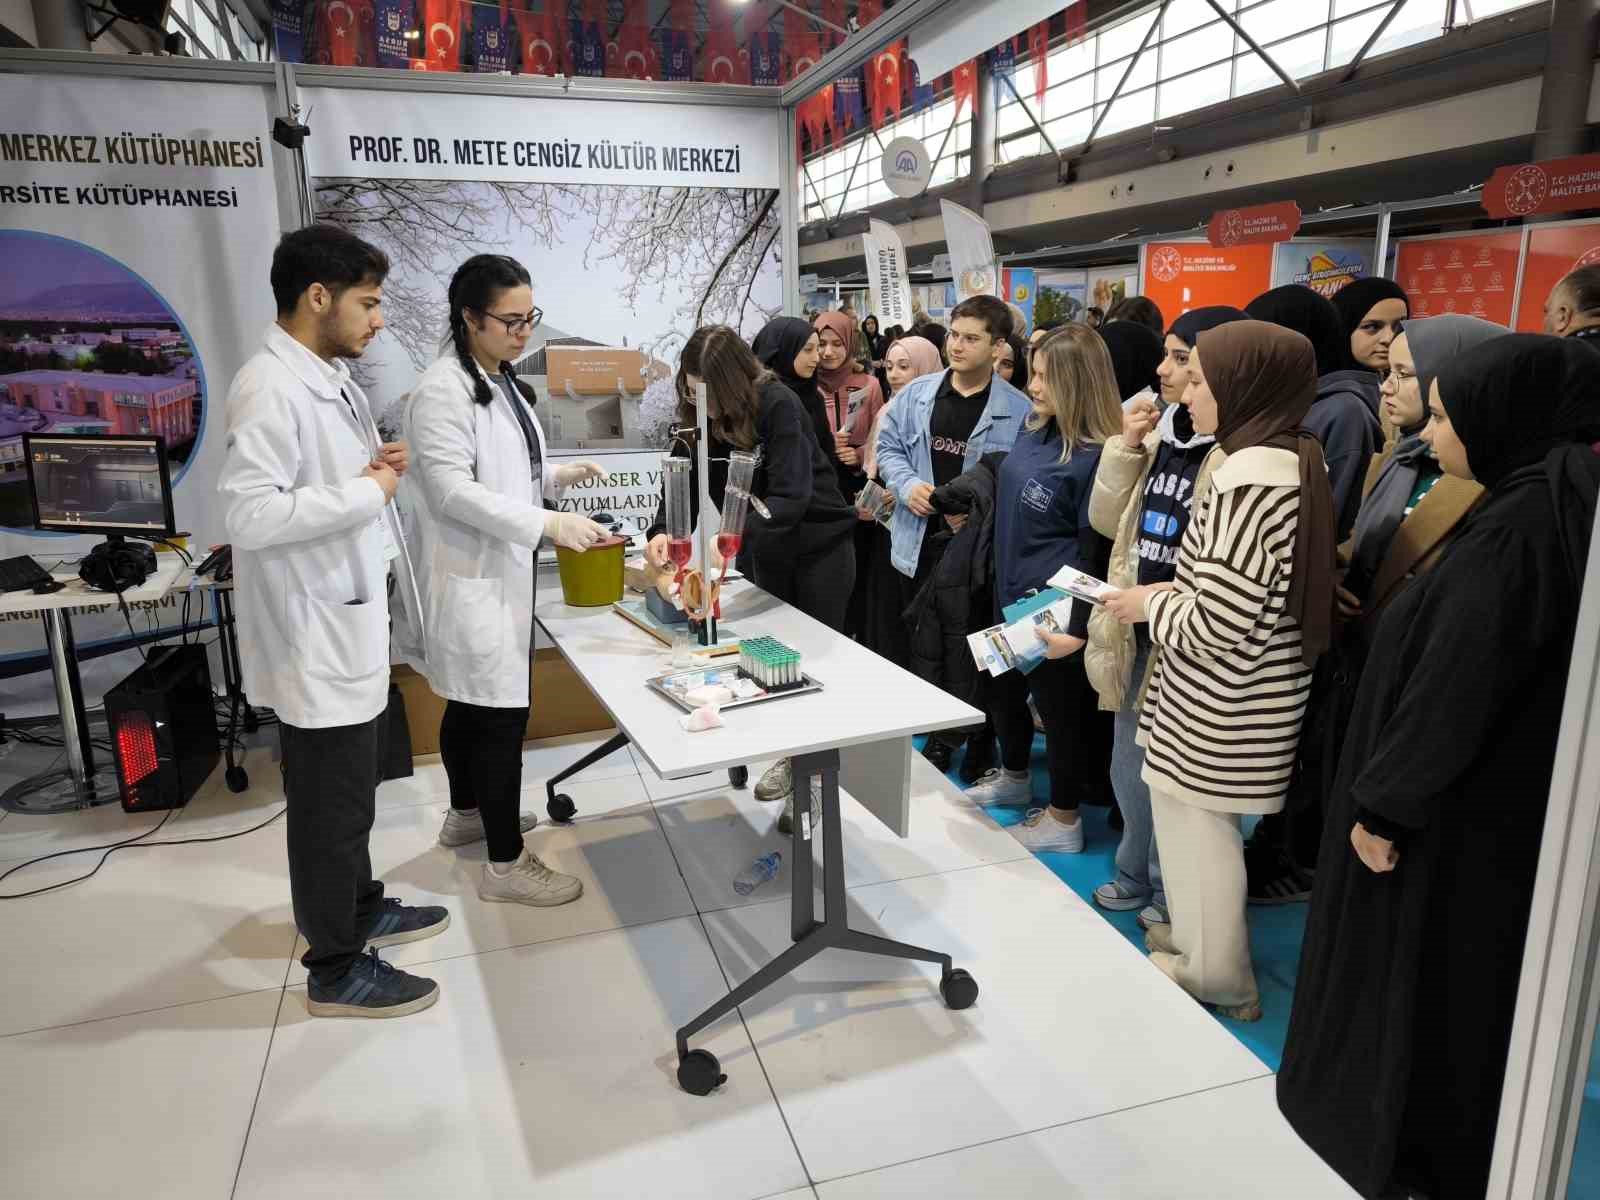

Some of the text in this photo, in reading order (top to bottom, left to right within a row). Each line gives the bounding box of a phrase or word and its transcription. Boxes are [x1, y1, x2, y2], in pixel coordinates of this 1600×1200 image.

[0, 131, 264, 168] MERKEZ KÜTÜPHANESİ
[349, 135, 740, 173] PROF. DR. METE CENGİZ KÜLTÜR MERKEZİ
[0, 181, 238, 208] RSİTE KÜTÜPHANESİ
